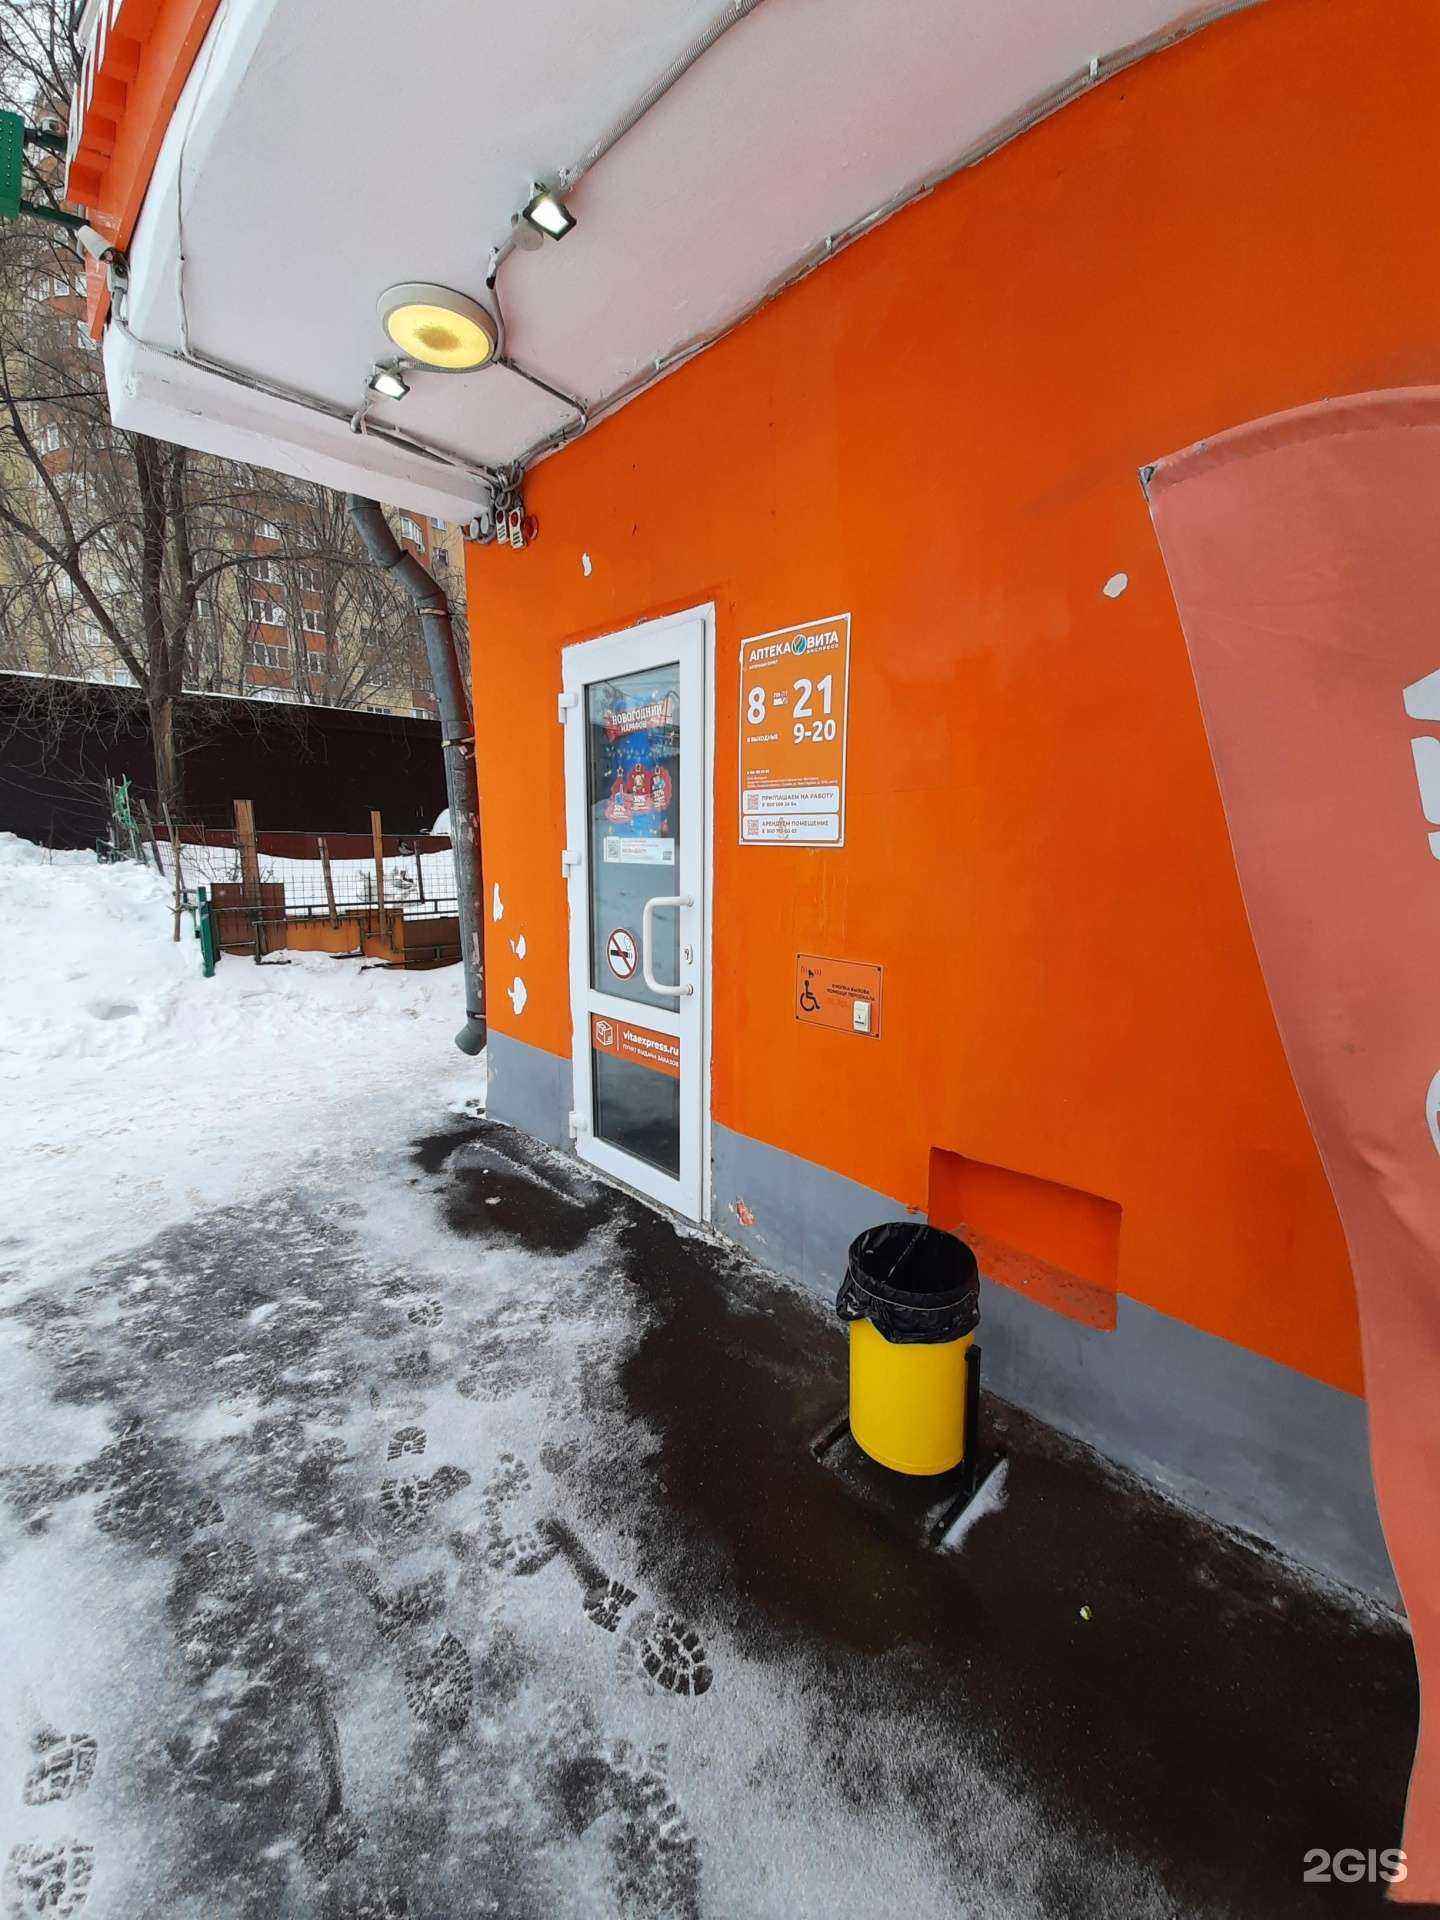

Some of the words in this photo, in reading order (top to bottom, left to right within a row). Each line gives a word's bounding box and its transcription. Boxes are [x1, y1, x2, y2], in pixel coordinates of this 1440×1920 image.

[749, 642, 791, 662] АПТЕКА
[806, 630, 839, 650] ВИТА
[747, 686, 766, 725] 8
[793, 674, 832, 718] 21
[793, 719, 836, 744] 9-20
[761, 793, 800, 801] ПРИГЛАШАЕМ
[800, 792, 810, 800] НА
[810, 792, 834, 800] РАБОТУ
[623, 1030, 679, 1056] vitaexpress.ru
